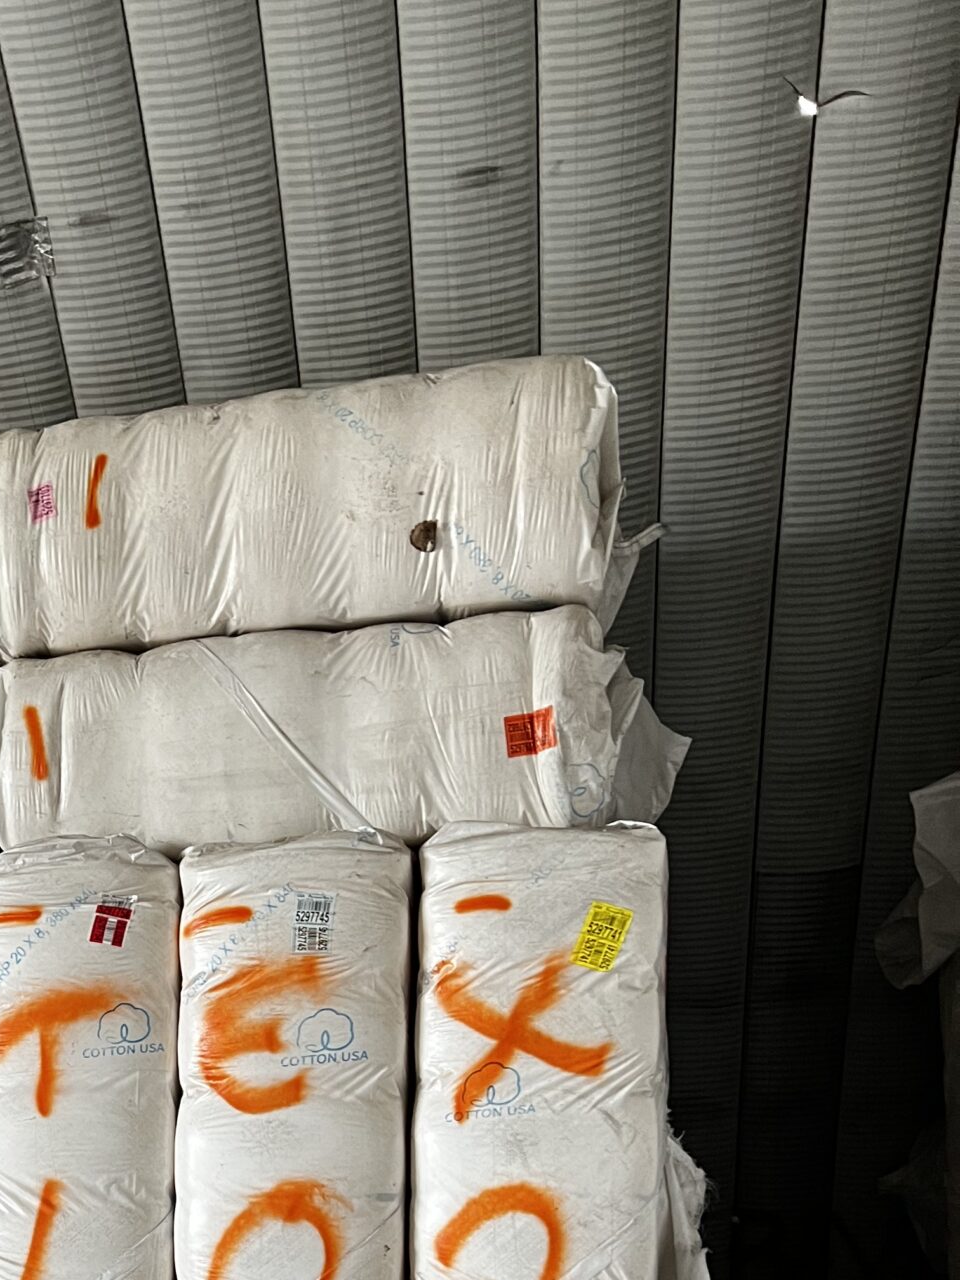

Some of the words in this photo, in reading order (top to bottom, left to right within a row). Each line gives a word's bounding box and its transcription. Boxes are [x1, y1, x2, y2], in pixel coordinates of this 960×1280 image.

[295, 911, 330, 924] 5297745
[10, 946, 26, 964] 20
[23, 934, 36, 948] X
[34, 926, 50, 940] 8,
[45, 908, 70, 929] 380
[206, 954, 222, 972] 20
[219, 943, 233, 956] X
[265, 900, 278, 913] X
[586, 922, 623, 942] 5297741
[82, 1046, 136, 1059] COTTON
[139, 1043, 165, 1054] USA
[280, 1052, 337, 1068] COTTON
[341, 1050, 369, 1062] USA
[445, 1106, 503, 1123] COTTON
[506, 1103, 536, 1116] USA
